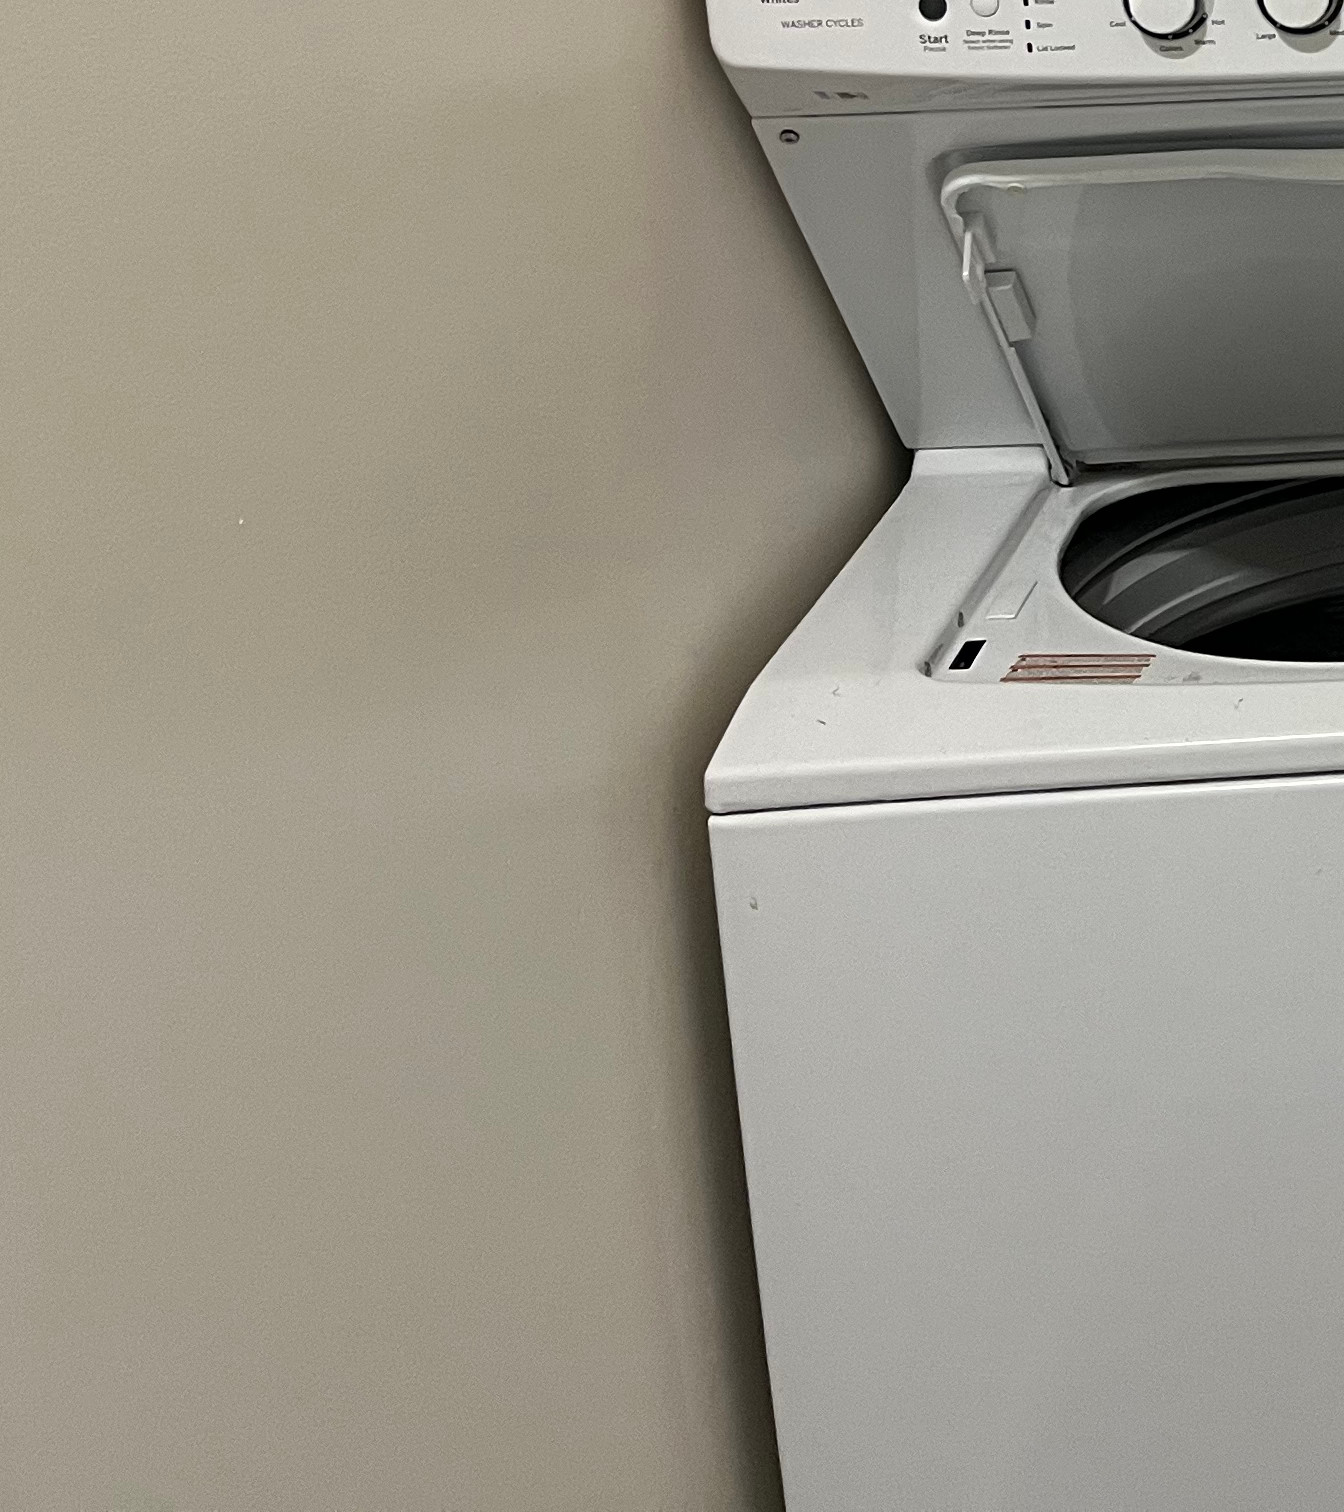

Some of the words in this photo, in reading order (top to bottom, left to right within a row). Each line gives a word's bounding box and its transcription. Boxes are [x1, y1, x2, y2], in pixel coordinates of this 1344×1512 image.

[781, 19, 823, 29] WASHER
[826, 18, 864, 28] CYCLES
[919, 34, 949, 44] Start
